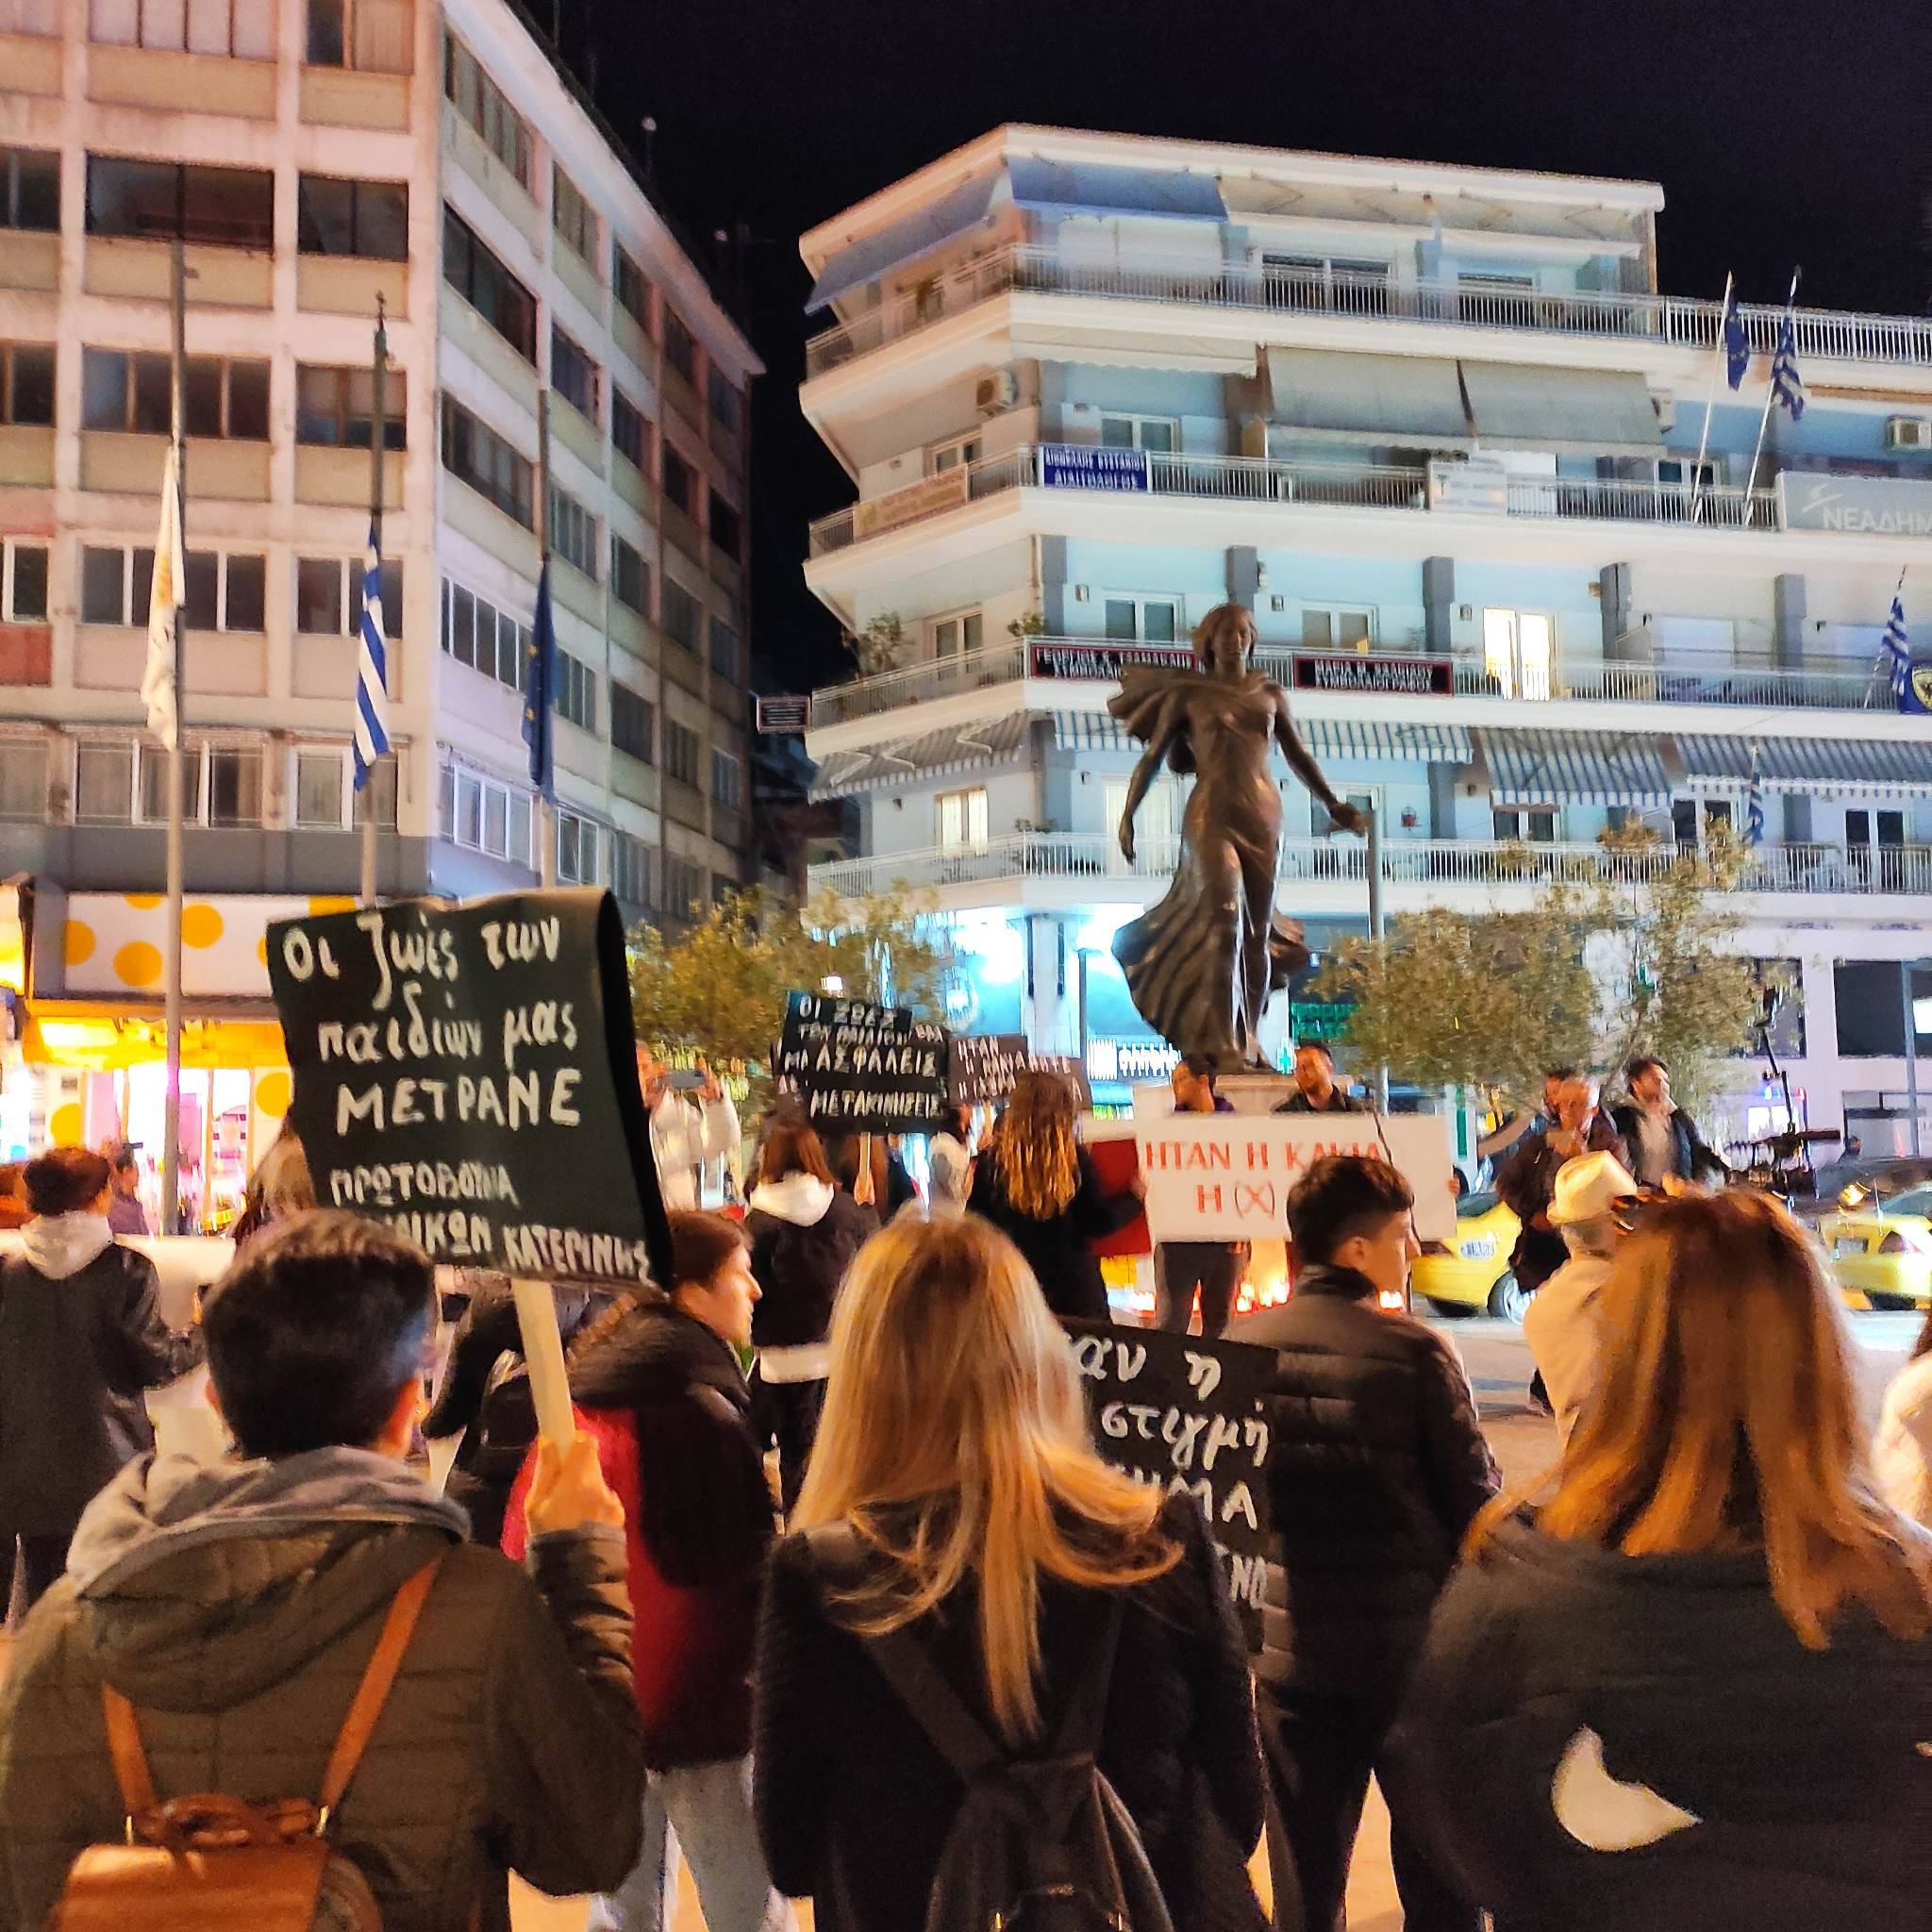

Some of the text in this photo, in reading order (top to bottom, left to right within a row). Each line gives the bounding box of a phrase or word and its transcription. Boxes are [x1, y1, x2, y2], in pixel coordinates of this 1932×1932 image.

[481, 915, 560, 971] των
[503, 1000, 579, 1073] μας
[336, 1068, 582, 1136] ΜΕΤΡΑΝΕ
[1145, 1141, 1231, 1171] ΗΤΑΝ
[1247, 1141, 1269, 1171] Η
[1196, 1184, 1223, 1214] Η
